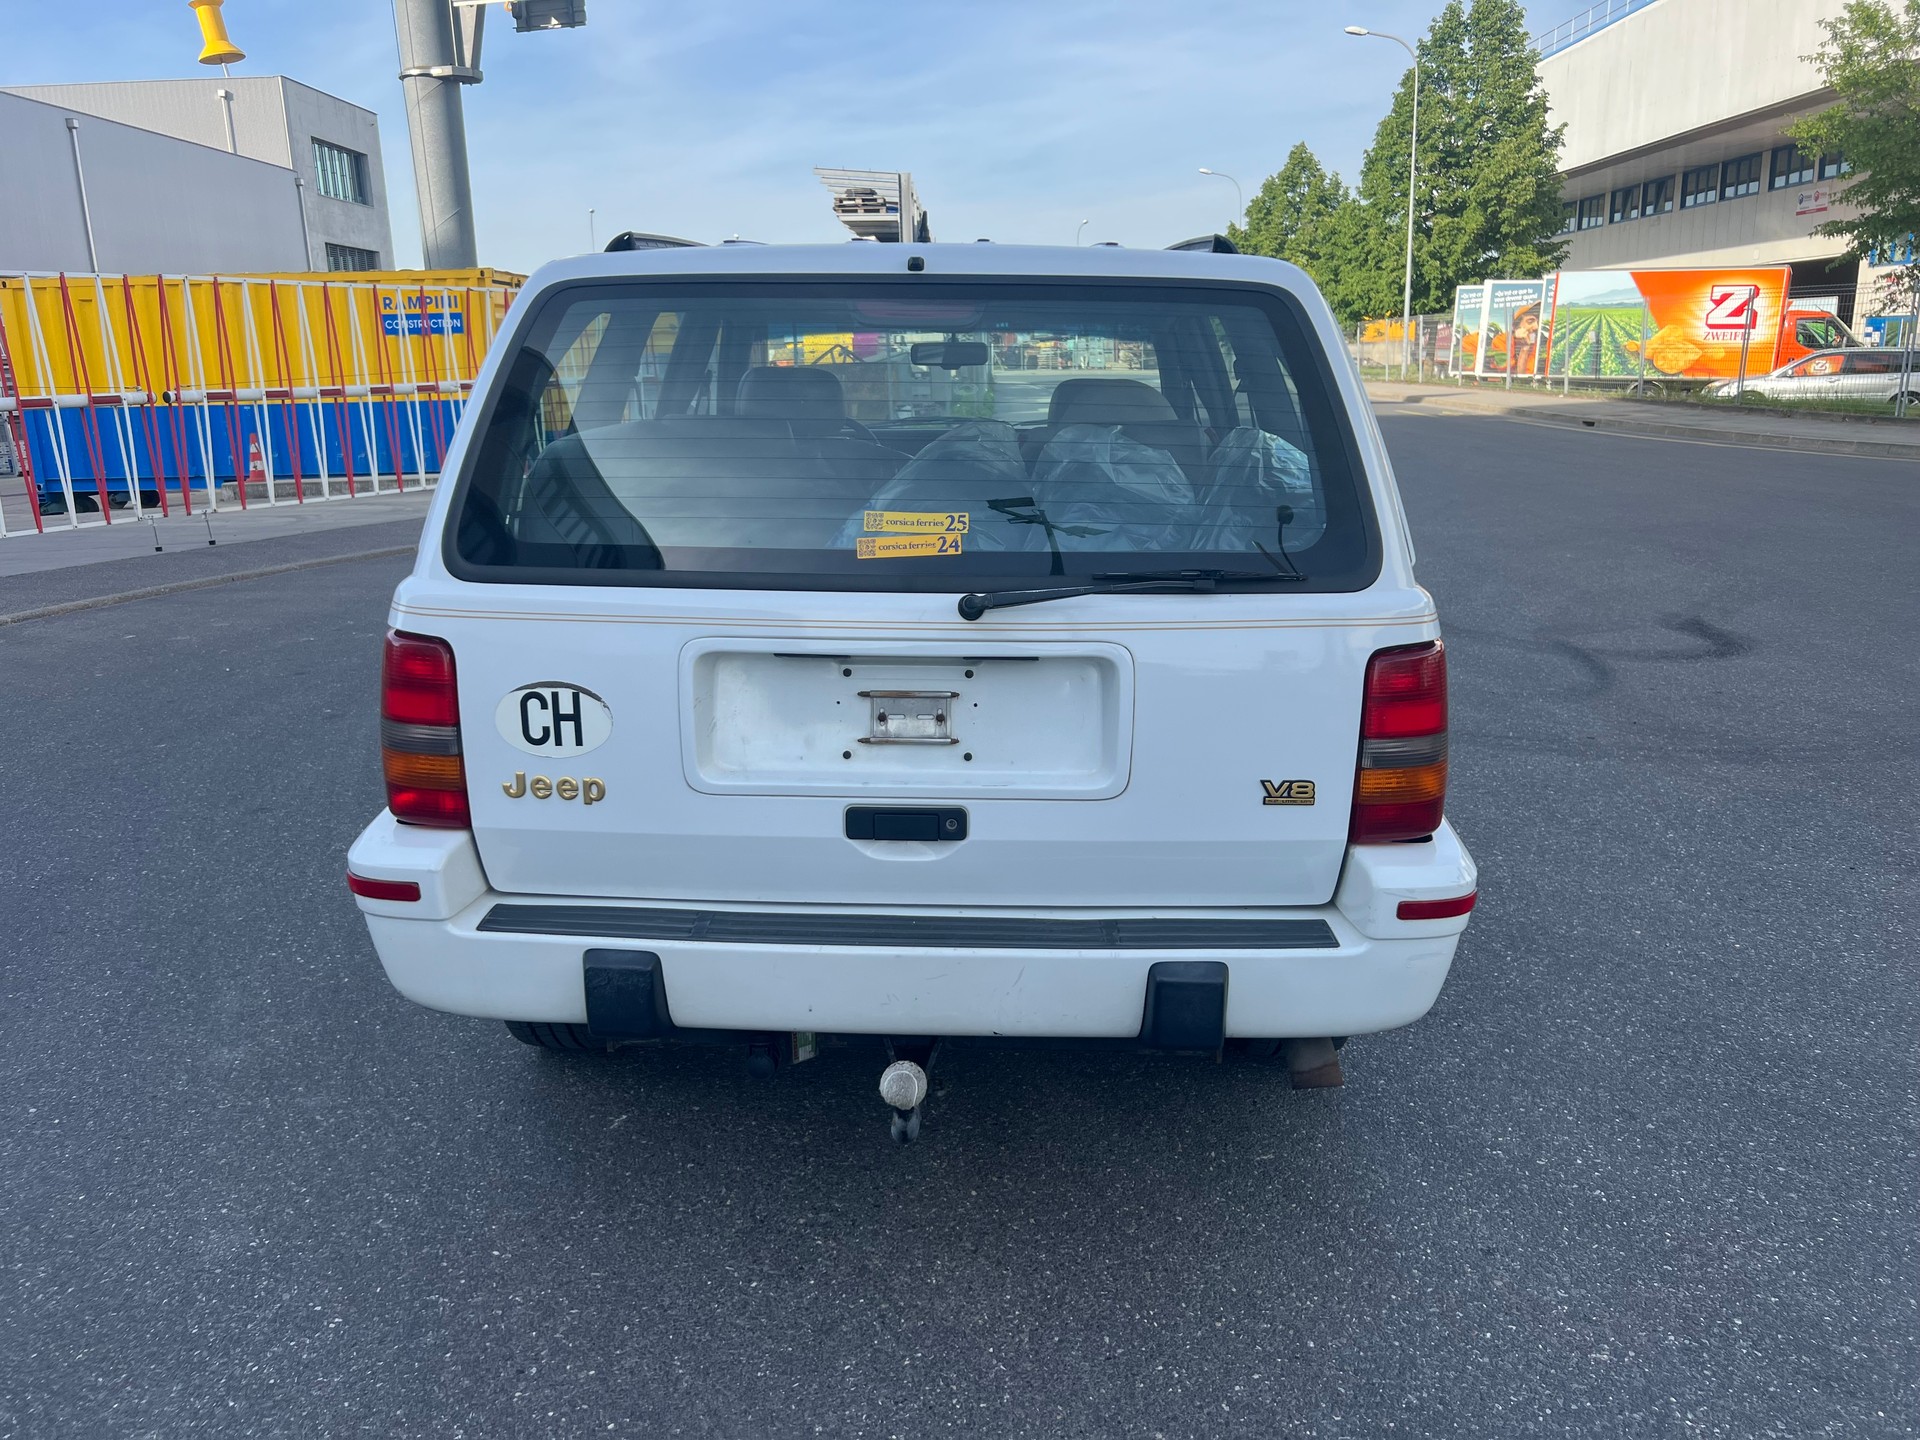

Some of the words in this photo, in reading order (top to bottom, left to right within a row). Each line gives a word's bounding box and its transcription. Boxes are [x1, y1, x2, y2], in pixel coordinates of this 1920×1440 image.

[886, 518, 914, 526] corsica
[916, 518, 944, 527] ferries
[945, 514, 967, 532] 25
[878, 541, 907, 551] corsica
[909, 540, 936, 550] ferries
[937, 535, 960, 553] 24
[520, 691, 583, 747] CH
[502, 770, 606, 805] Jeep
[1261, 780, 1315, 798] V8
